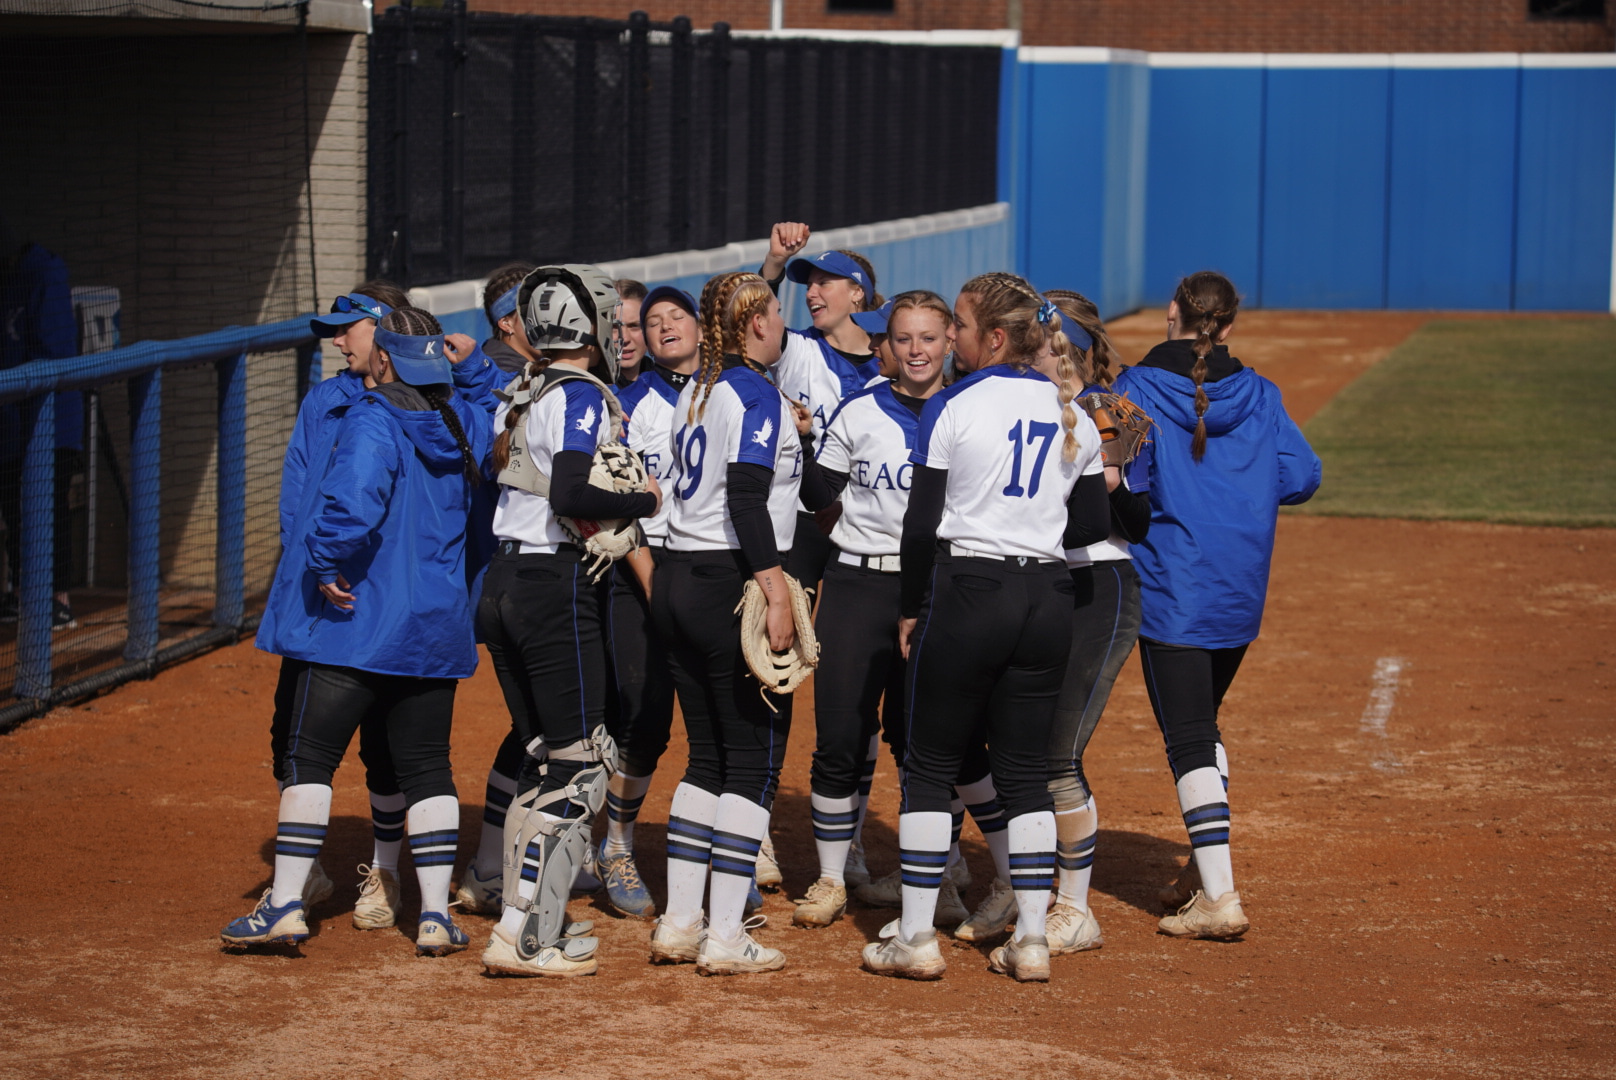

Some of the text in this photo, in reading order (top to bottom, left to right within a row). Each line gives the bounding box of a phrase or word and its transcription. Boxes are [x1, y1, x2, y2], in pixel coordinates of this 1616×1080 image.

[425, 341, 436, 355] K
[675, 423, 706, 500] 19
[1002, 418, 1059, 499] 17
[857, 460, 914, 491] EAG
[743, 943, 759, 961] N
